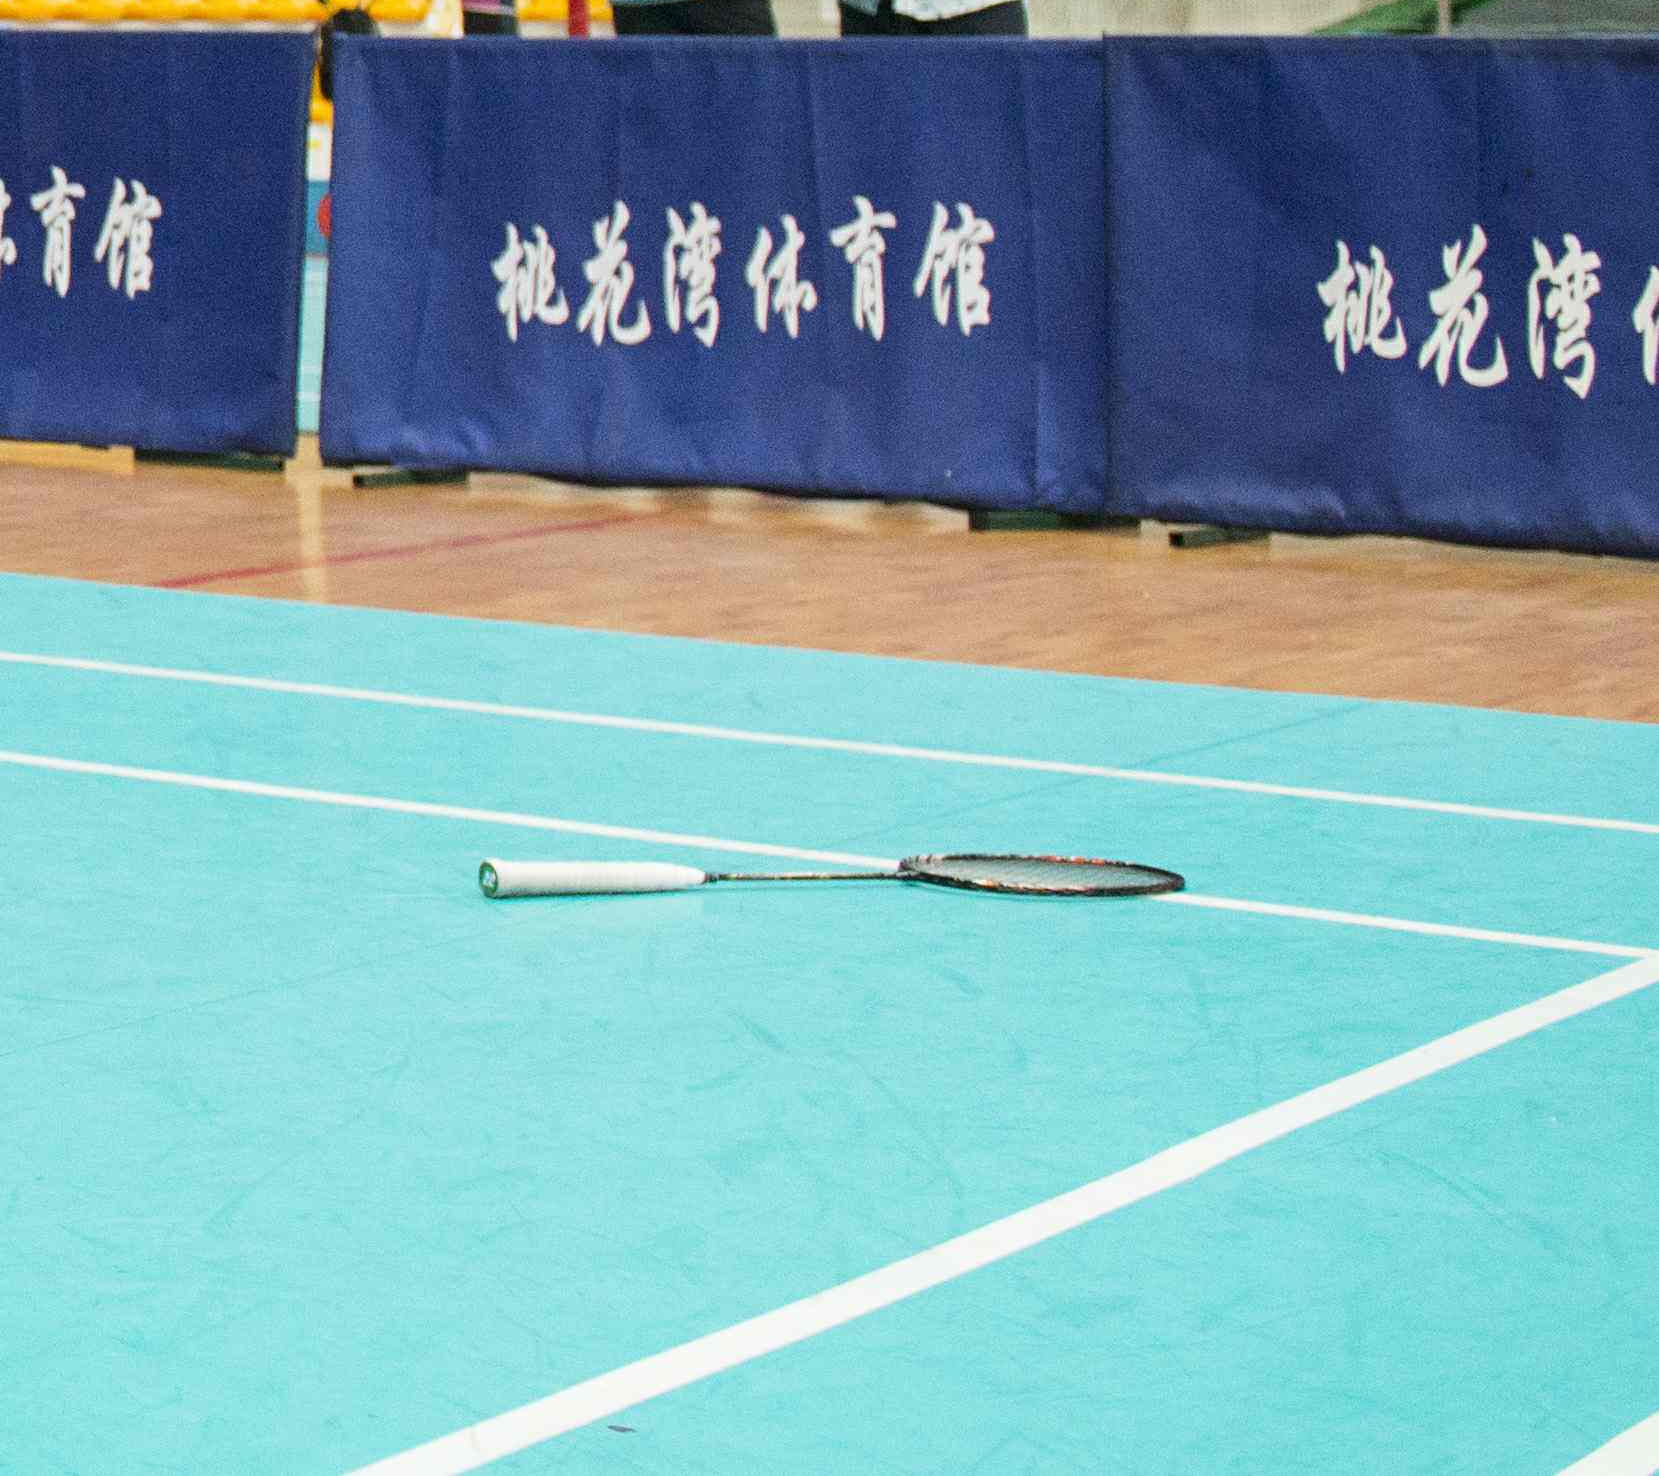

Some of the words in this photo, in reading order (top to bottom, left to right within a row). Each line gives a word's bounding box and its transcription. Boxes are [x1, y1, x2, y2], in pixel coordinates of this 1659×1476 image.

[491, 195, 996, 348] 桃花湾体育馆
